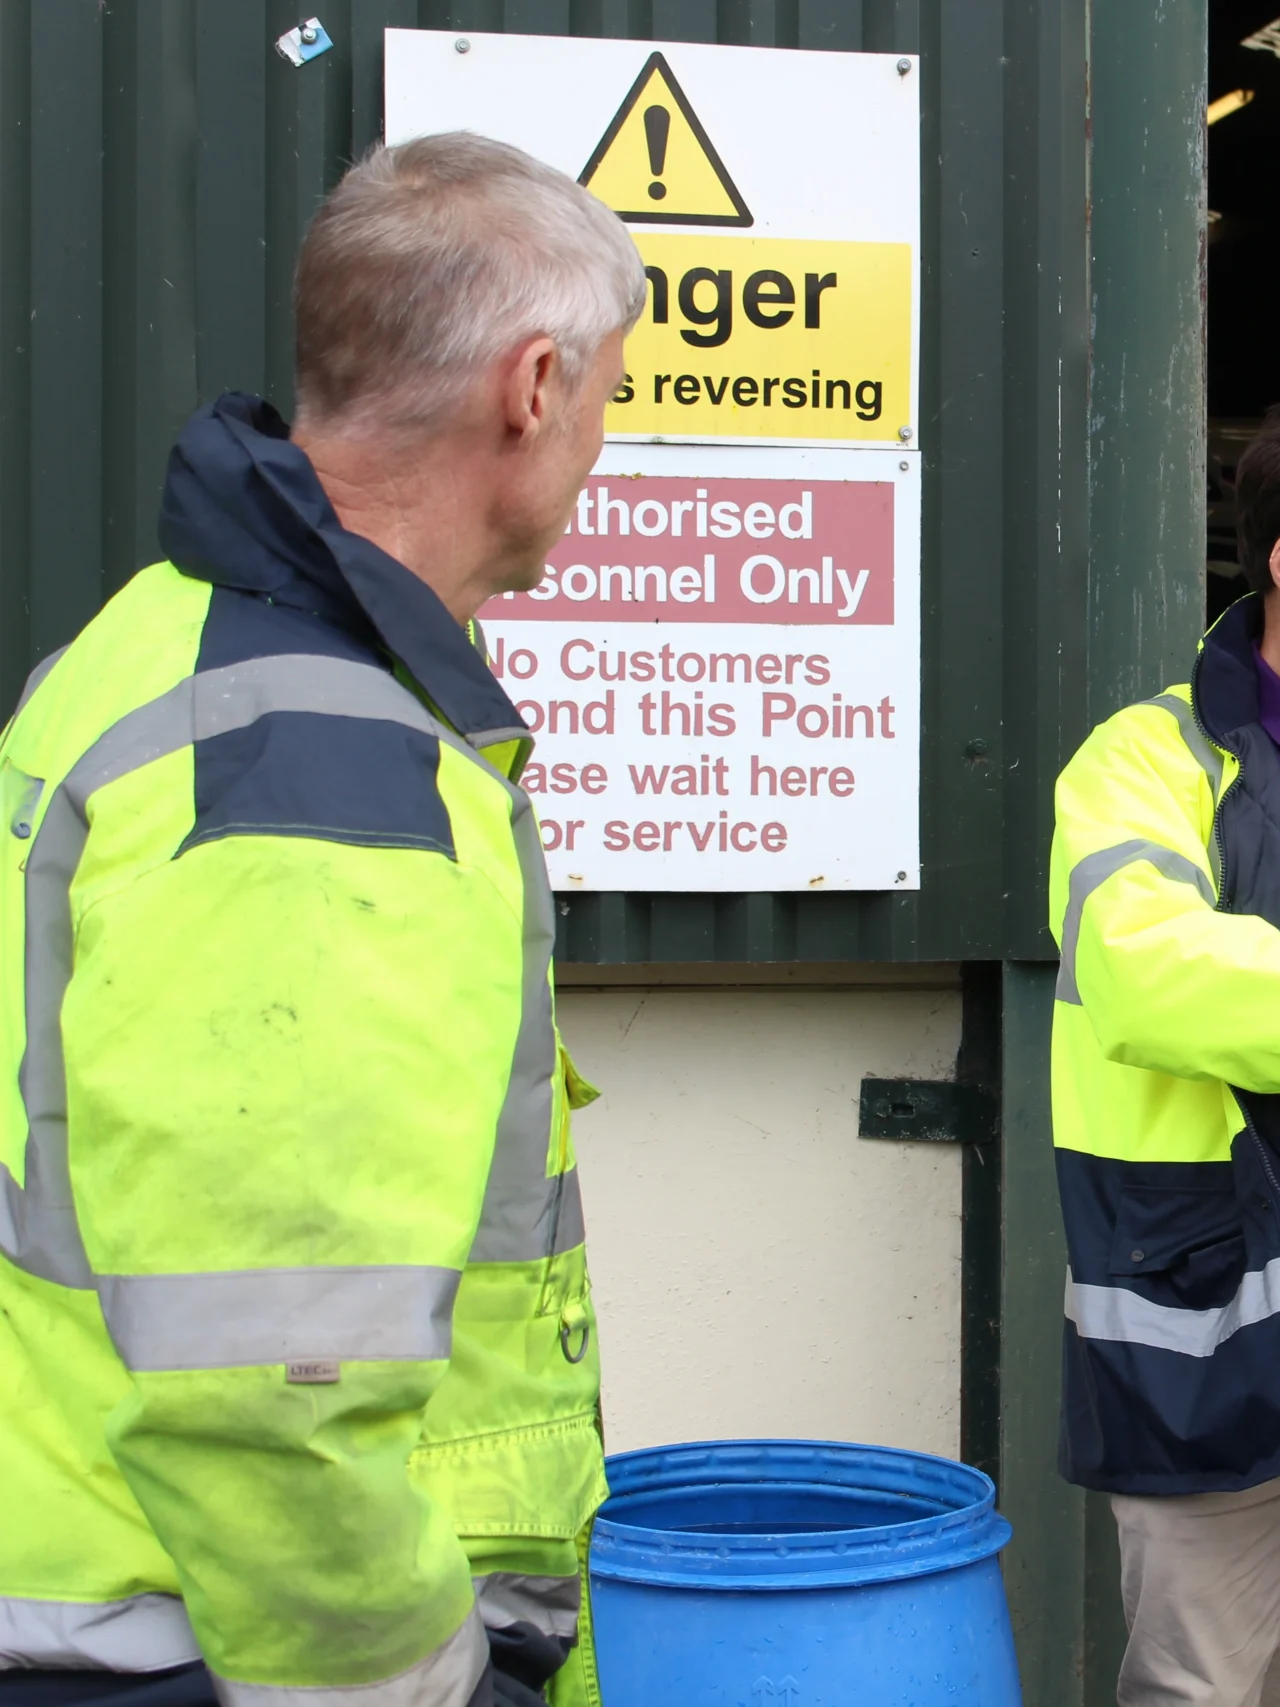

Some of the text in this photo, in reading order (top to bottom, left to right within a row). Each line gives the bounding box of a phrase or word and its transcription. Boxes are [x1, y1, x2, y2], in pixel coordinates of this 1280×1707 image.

[654, 369, 883, 421] reversing
[565, 486, 813, 540] thorised
[503, 554, 870, 619] sonnel Only
[560, 638, 831, 686] Customers
[515, 690, 896, 739] ond this Point
[521, 754, 855, 797] ase wait here
[603, 811, 788, 852] service
